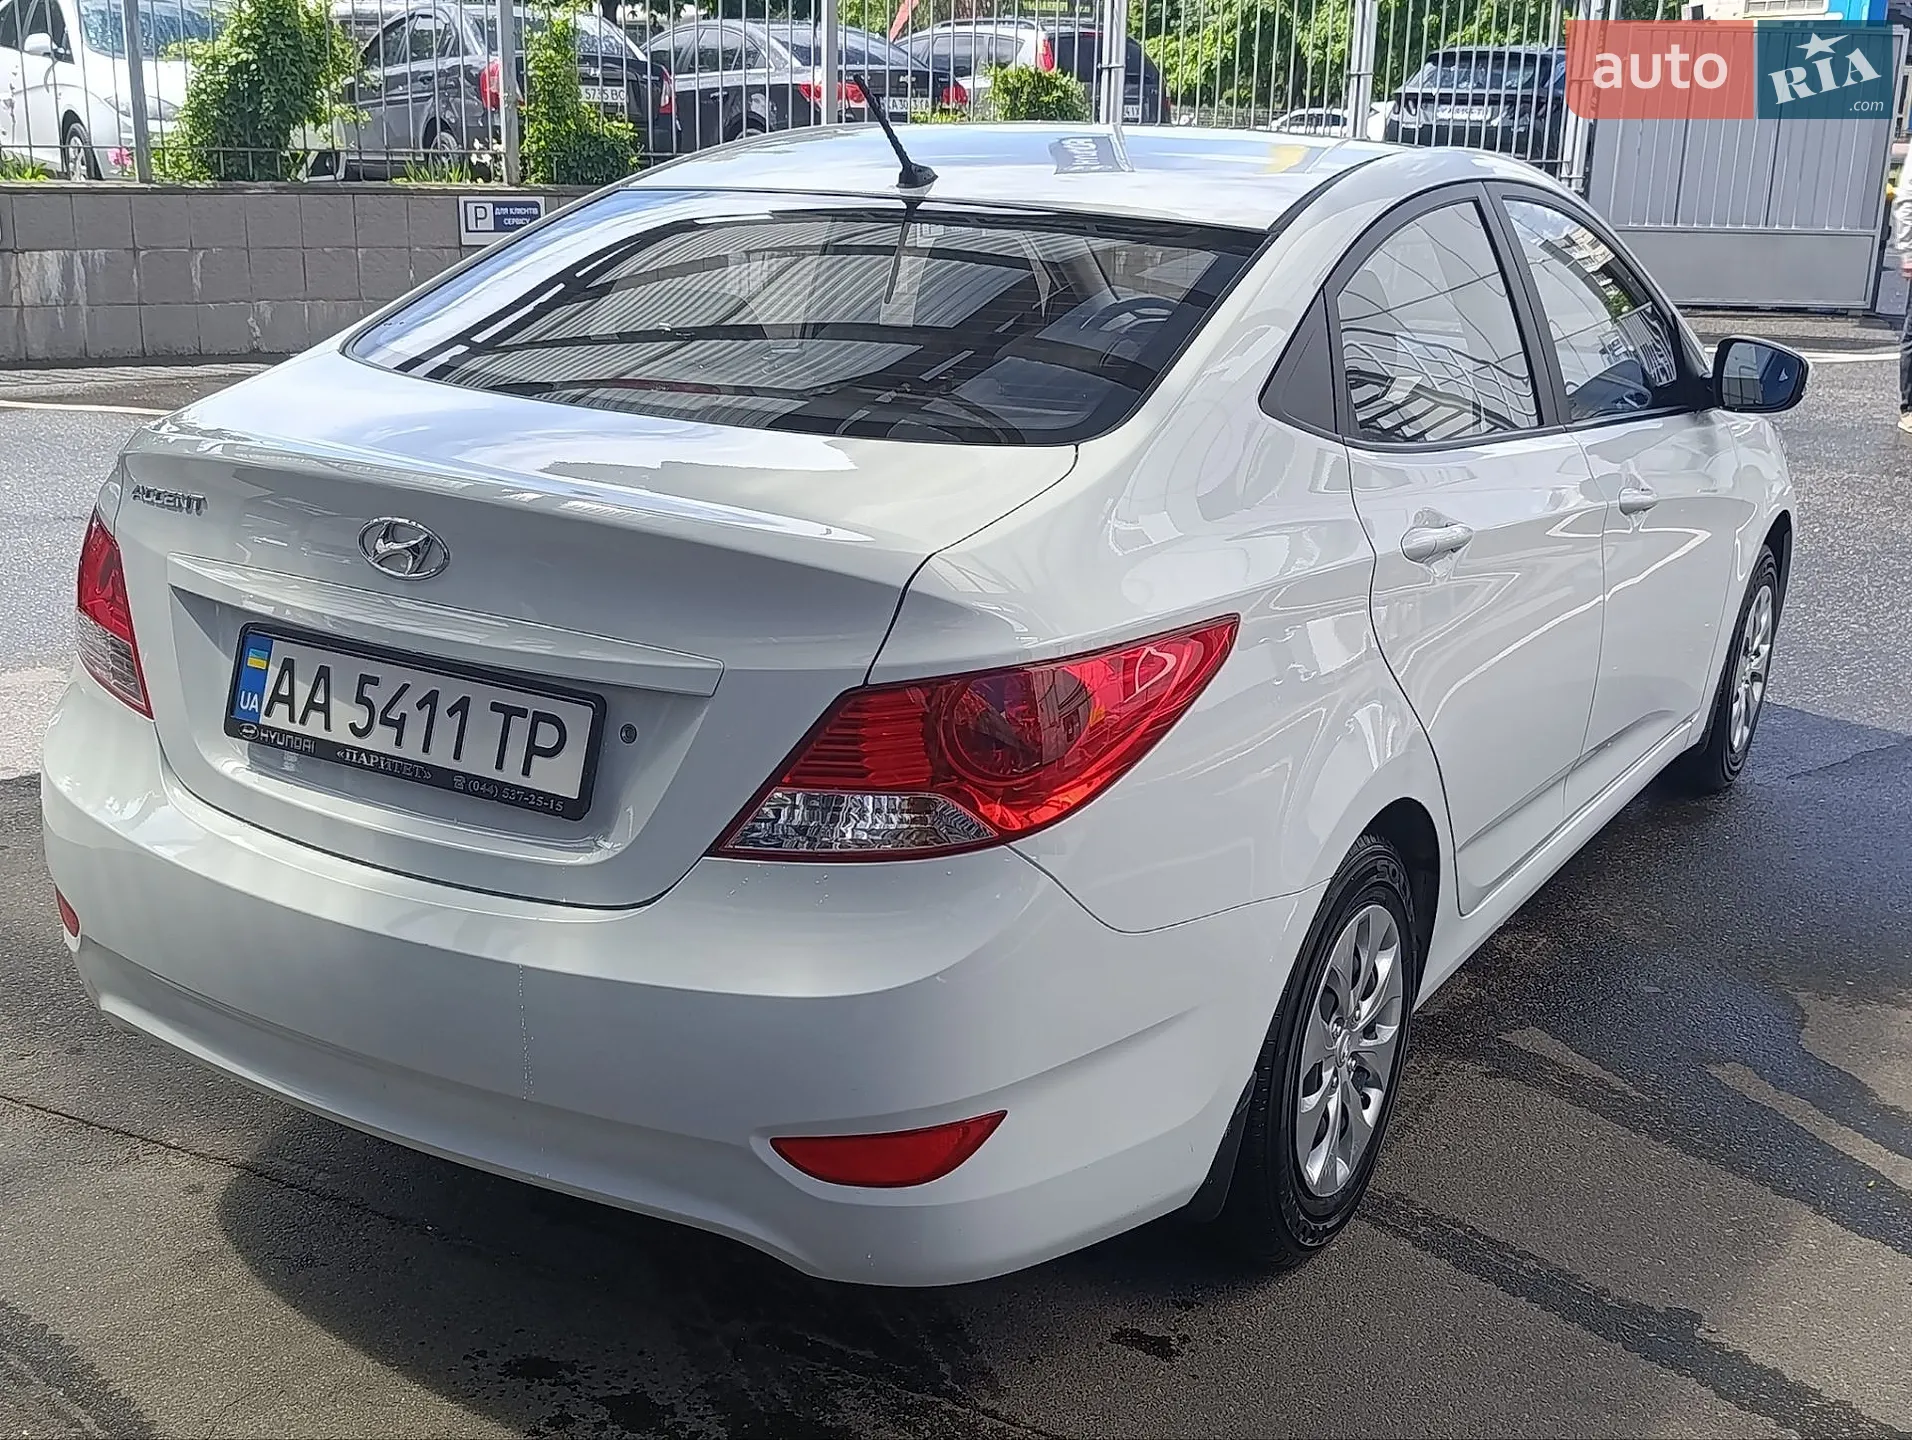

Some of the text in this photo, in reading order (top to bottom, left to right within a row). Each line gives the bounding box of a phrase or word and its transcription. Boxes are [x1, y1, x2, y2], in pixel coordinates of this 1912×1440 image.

[474, 205, 488, 229] P
[132, 484, 208, 516] ACCENT
[239, 689, 259, 713] UA
[264, 656, 568, 778] AA 5411 TP
[259, 728, 316, 754] HYUNDAI
[336, 748, 433, 780] «ПАРИТЕТ»
[467, 779, 565, 813] (044) 537-25-15
